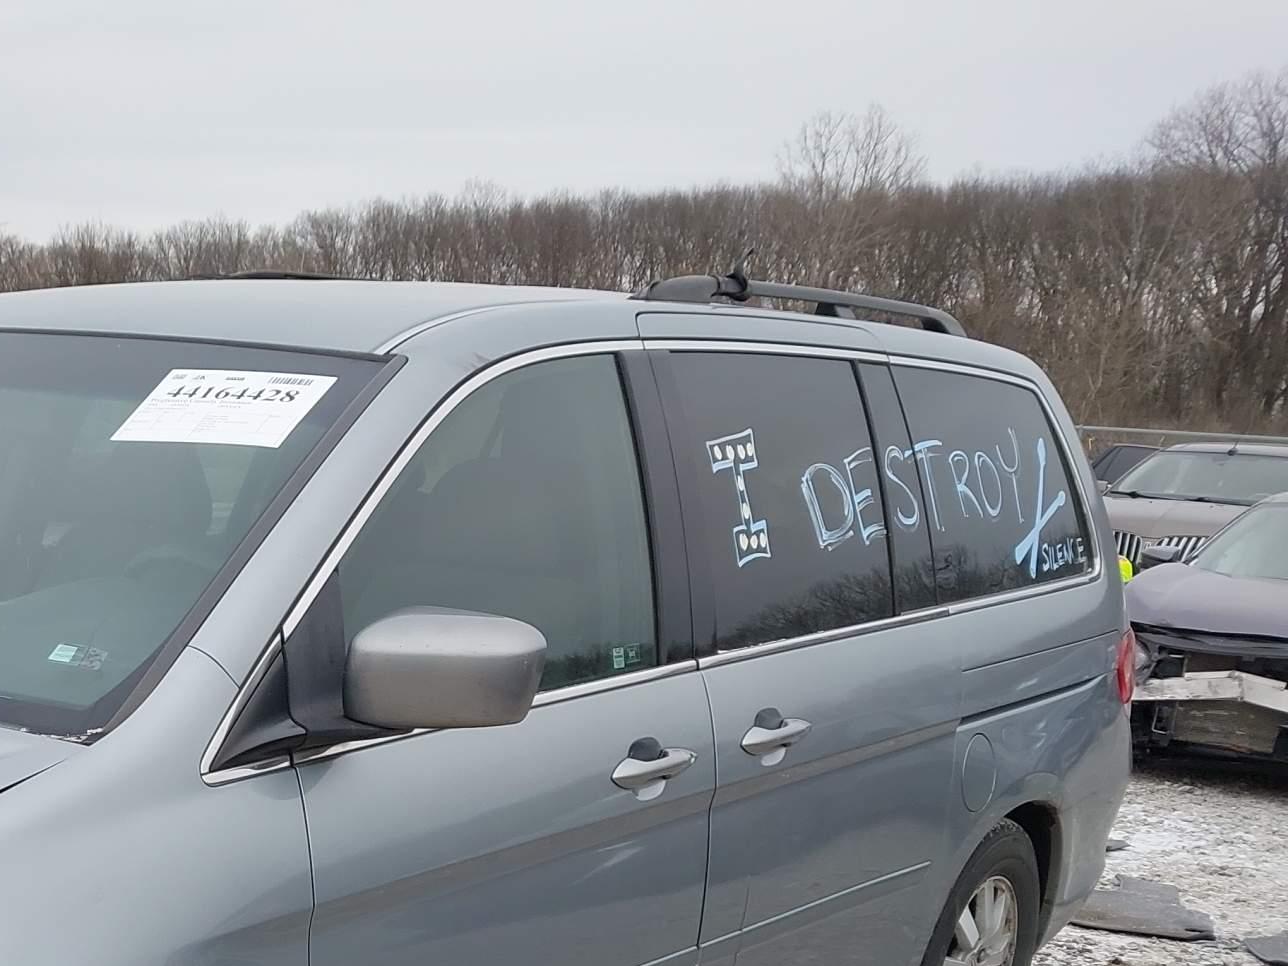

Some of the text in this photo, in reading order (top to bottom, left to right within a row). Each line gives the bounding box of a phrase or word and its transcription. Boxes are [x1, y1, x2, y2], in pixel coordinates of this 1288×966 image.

[167, 385, 300, 403] 44164428
[705, 427, 1024, 568] I DESTROY
